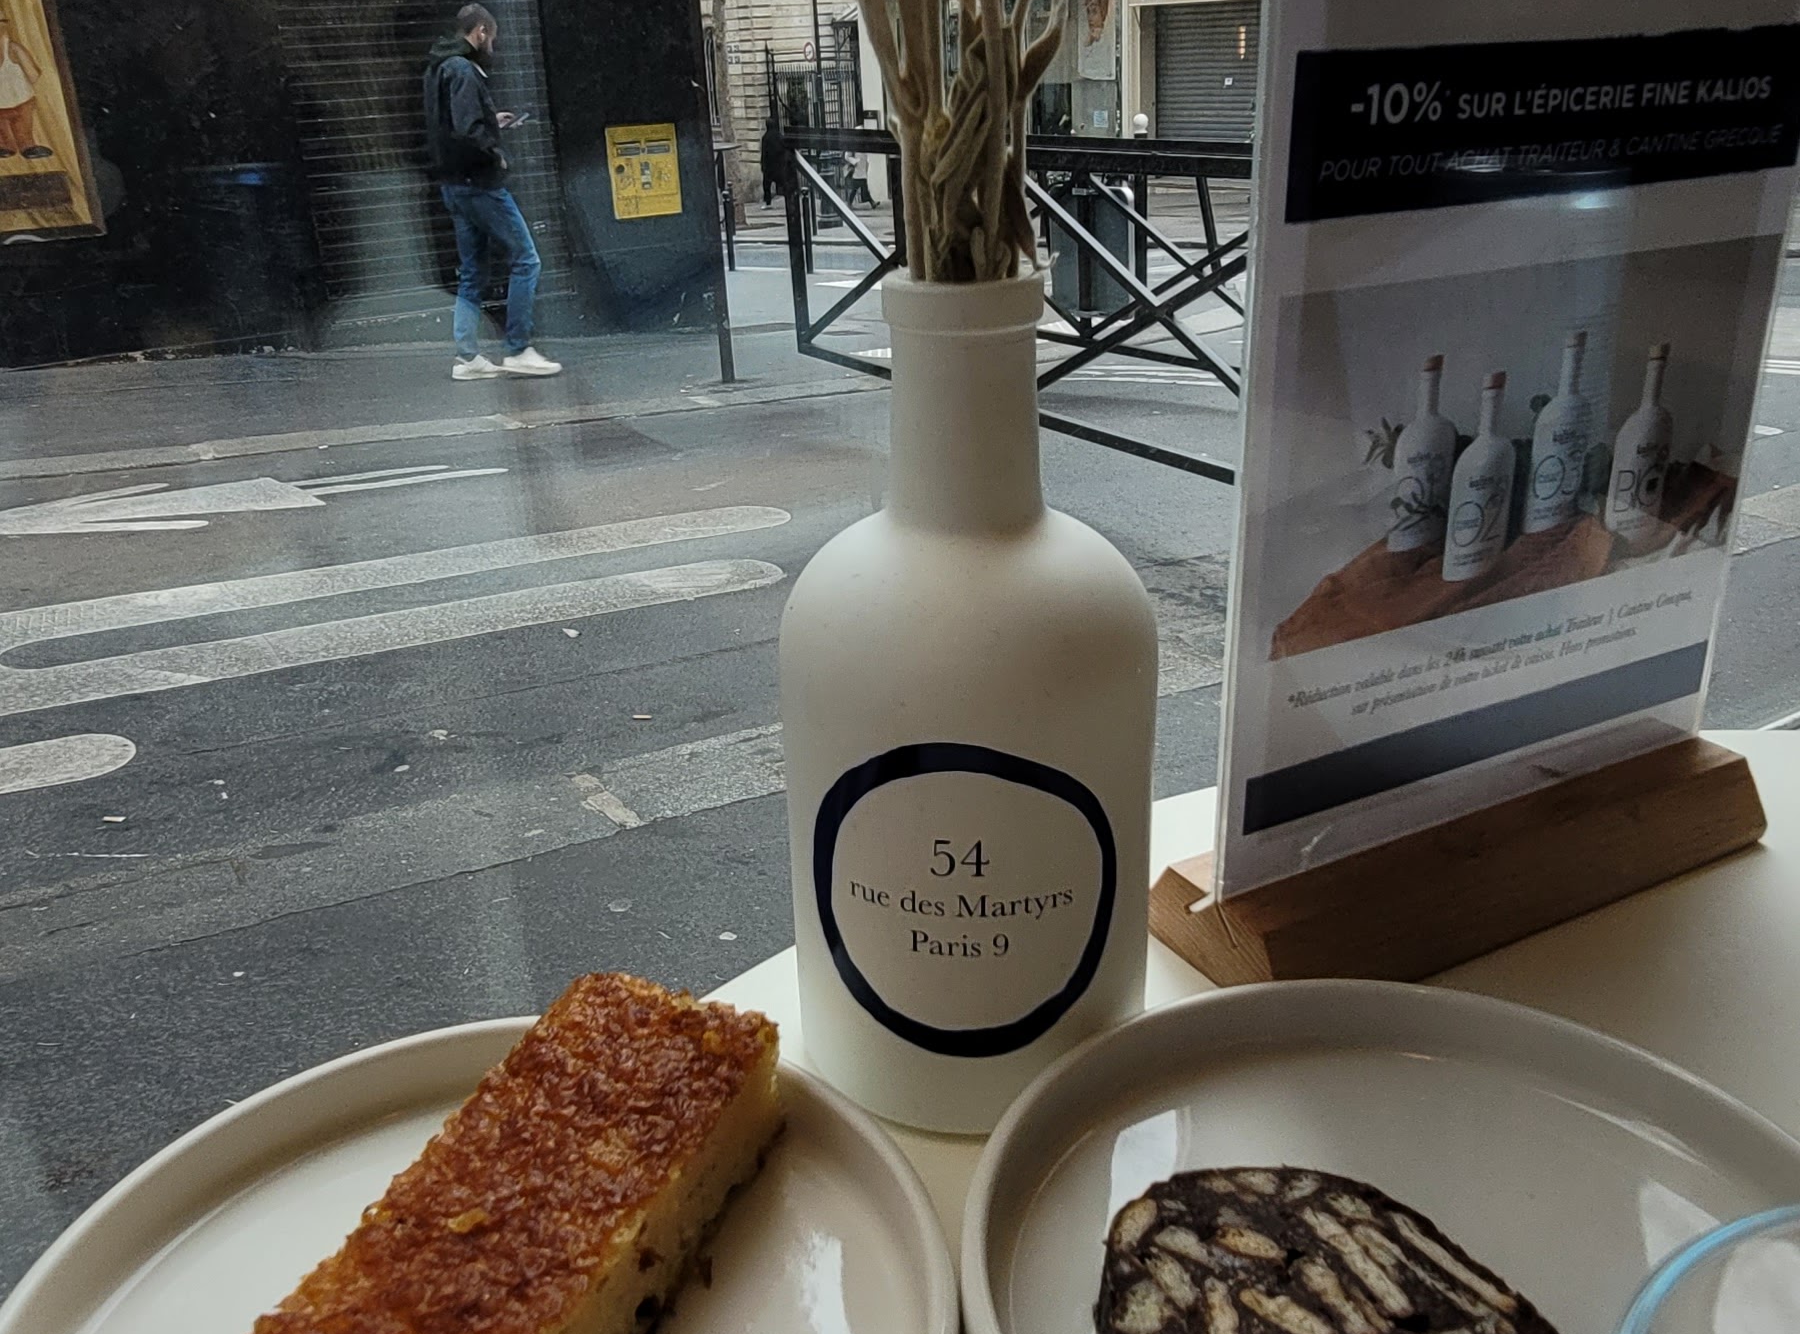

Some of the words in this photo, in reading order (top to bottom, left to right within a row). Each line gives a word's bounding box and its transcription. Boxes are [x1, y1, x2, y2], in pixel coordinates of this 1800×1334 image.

[1456, 90, 1508, 120] SUR
[1512, 83, 1637, 116] L'ÉPICERIE
[1640, 79, 1694, 108] FINE
[1695, 74, 1774, 105] KALIOS
[1317, 156, 1383, 183] POUR
[1387, 151, 1444, 177] TOUT
[1445, 145, 1514, 173] ACHAT
[1517, 138, 1608, 166] TRAITEUR
[1608, 138, 1621, 158] &
[1625, 130, 1701, 156] CANTINE
[928, 838, 991, 878] 54
[850, 878, 890, 908] rue
[899, 890, 945, 917] des
[956, 887, 1074, 920] Martyrs
[910, 929, 982, 958] Paris
[992, 933, 1010, 958] 9
